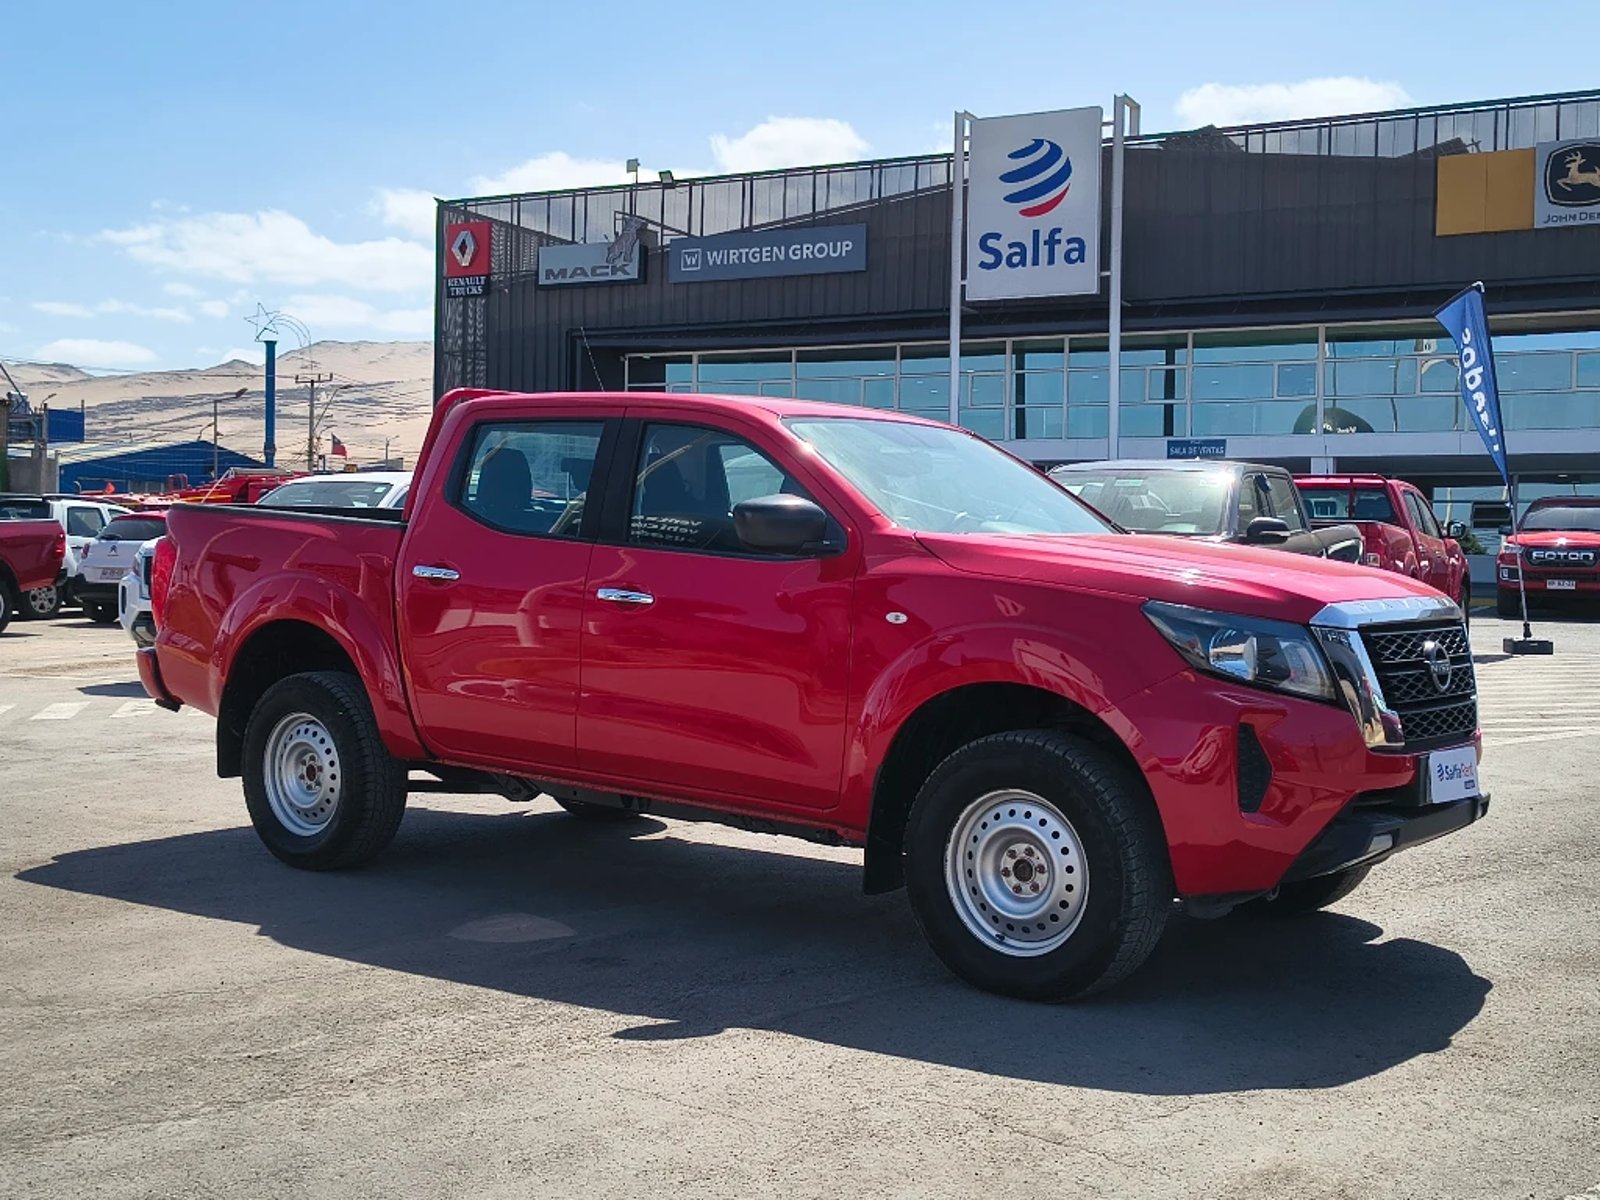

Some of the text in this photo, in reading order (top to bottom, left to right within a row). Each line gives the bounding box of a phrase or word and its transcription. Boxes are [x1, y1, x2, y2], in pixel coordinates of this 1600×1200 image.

[1543, 214, 1577, 223] JOHN
[706, 240, 853, 266] WIRTGEN GROUP
[978, 227, 1087, 270] Salfa
[545, 263, 632, 280] MACK
[447, 276, 487, 287] RENAULT
[450, 285, 484, 296] TRUCKS
[1169, 445, 1225, 455] SALA DE VENTAS
[1532, 550, 1594, 561] FOTON
